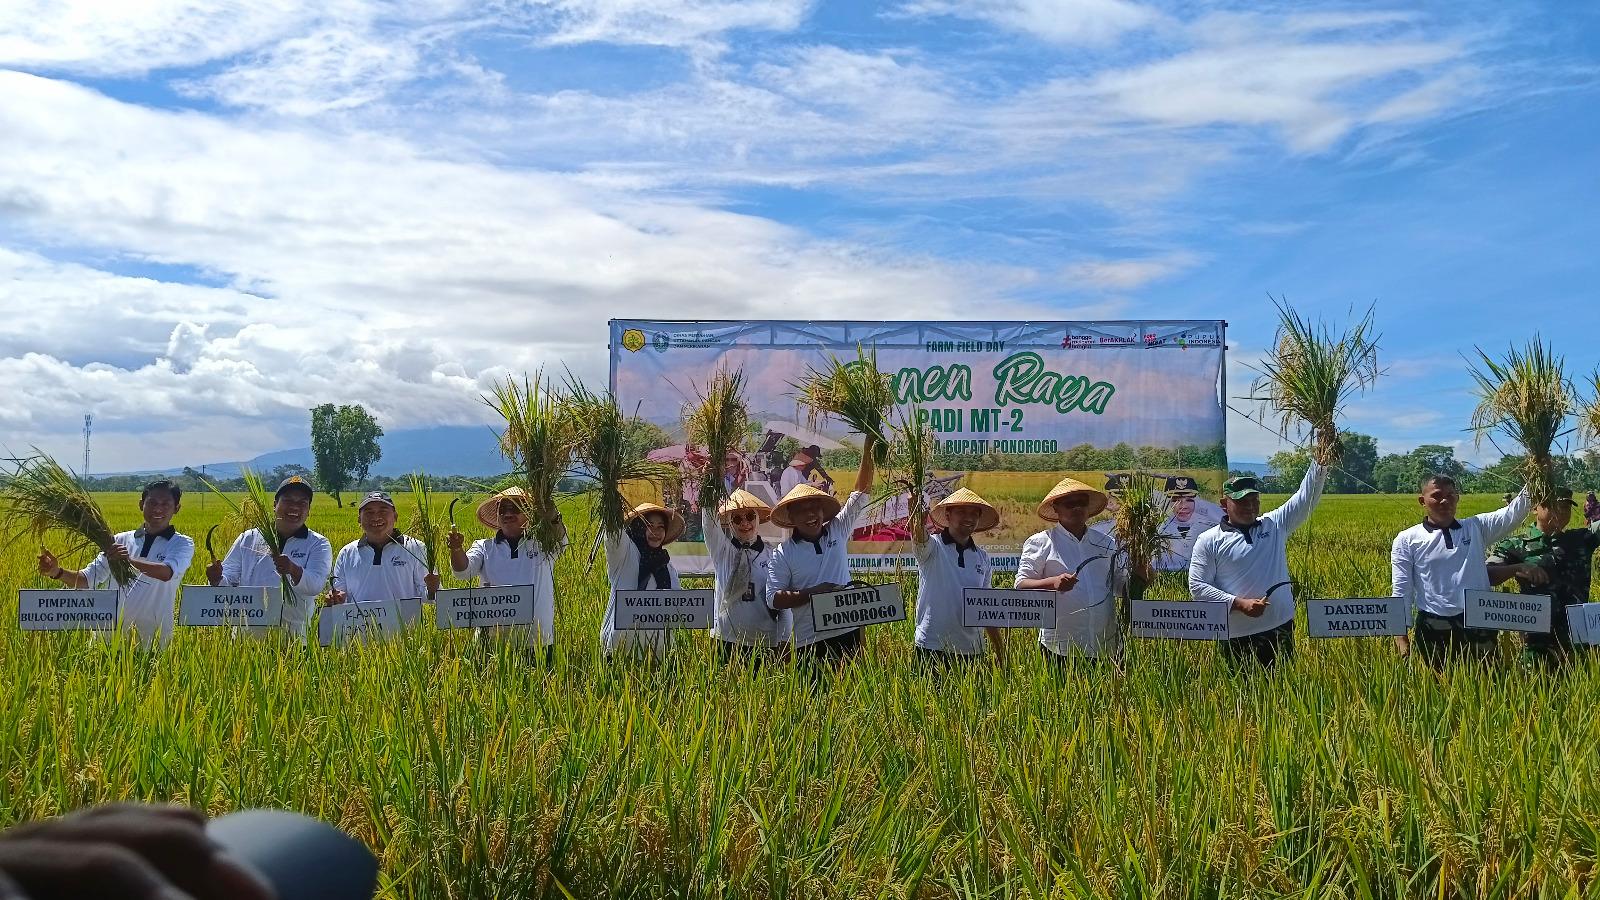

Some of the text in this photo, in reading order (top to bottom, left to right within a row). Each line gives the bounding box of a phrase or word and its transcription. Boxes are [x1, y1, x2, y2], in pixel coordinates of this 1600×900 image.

[926, 341, 1005, 353] FARM FIELD DAY
[993, 352, 1116, 415] Raya
[919, 408, 1024, 432] PADI MT-2
[945, 440, 989, 455] BUPATI
[993, 440, 1058, 455] PONOROGO
[38, 597, 95, 609] PIMPINAN
[214, 594, 254, 606] KAJARI
[452, 594, 521, 608] KETUA DPRD
[625, 596, 706, 608] WAKIL BUPATI
[834, 589, 882, 608] BUPATI
[966, 597, 1055, 609] WAKIL GUBERNUR
[1324, 603, 1389, 616] DANREM
[1478, 597, 1543, 613] DANDIM 0802
[20, 611, 113, 623] BULOG PONOROGO
[200, 608, 265, 619] PONOROGO
[456, 608, 517, 620] PONOROGO
[632, 613, 695, 624] PONOROGO
[822, 604, 897, 627] PONOROGO
[978, 610, 1042, 622] JAWA TIMUR
[1151, 608, 1208, 620] DIREKTUR
[1484, 611, 1538, 625] PONOROGO
[1132, 620, 1227, 633] PERLINDUNGAN TAN
[1328, 619, 1388, 632] MADIUN
